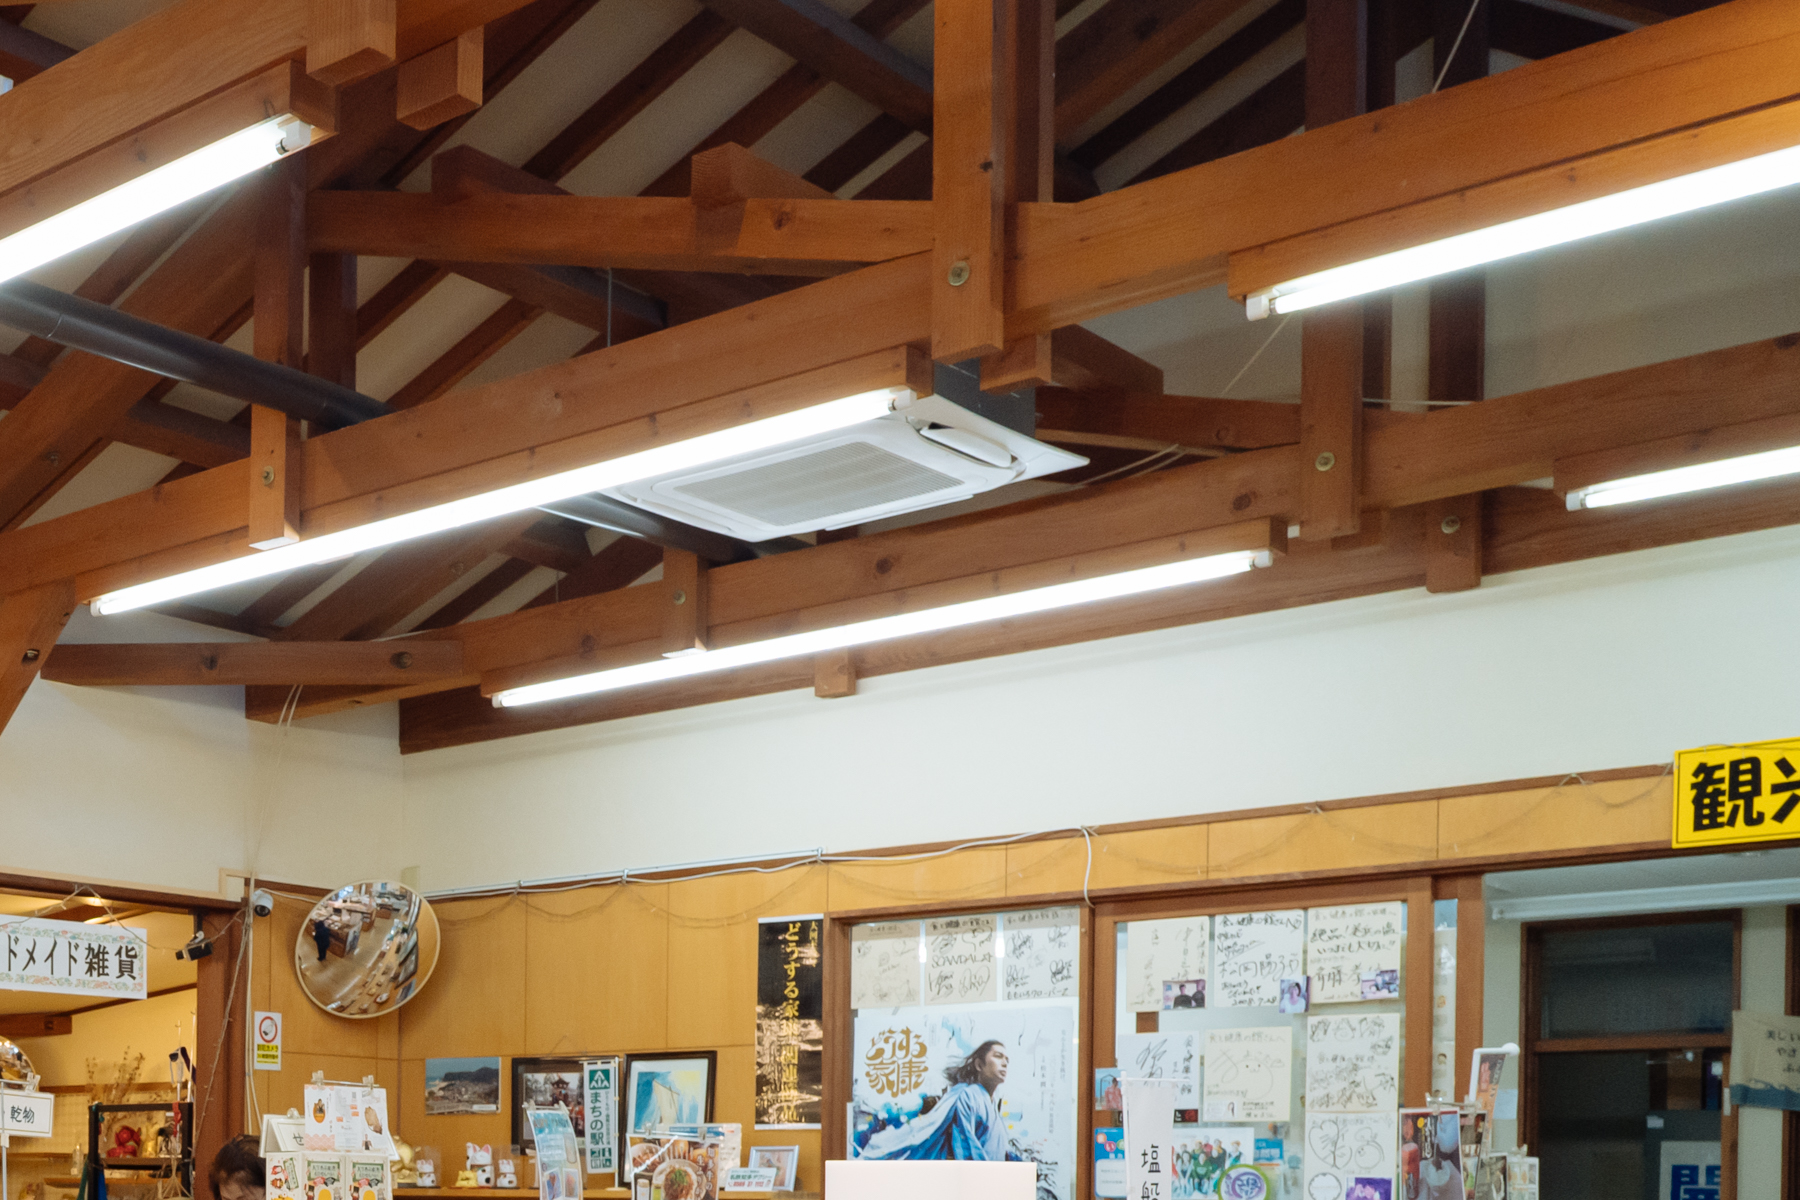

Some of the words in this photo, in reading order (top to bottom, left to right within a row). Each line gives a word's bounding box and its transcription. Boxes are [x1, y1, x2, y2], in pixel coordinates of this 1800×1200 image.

[866, 1026, 928, 1059] どうする
[865, 1060, 929, 1098] 家康
[589, 1092, 604, 1146] まちの駅
